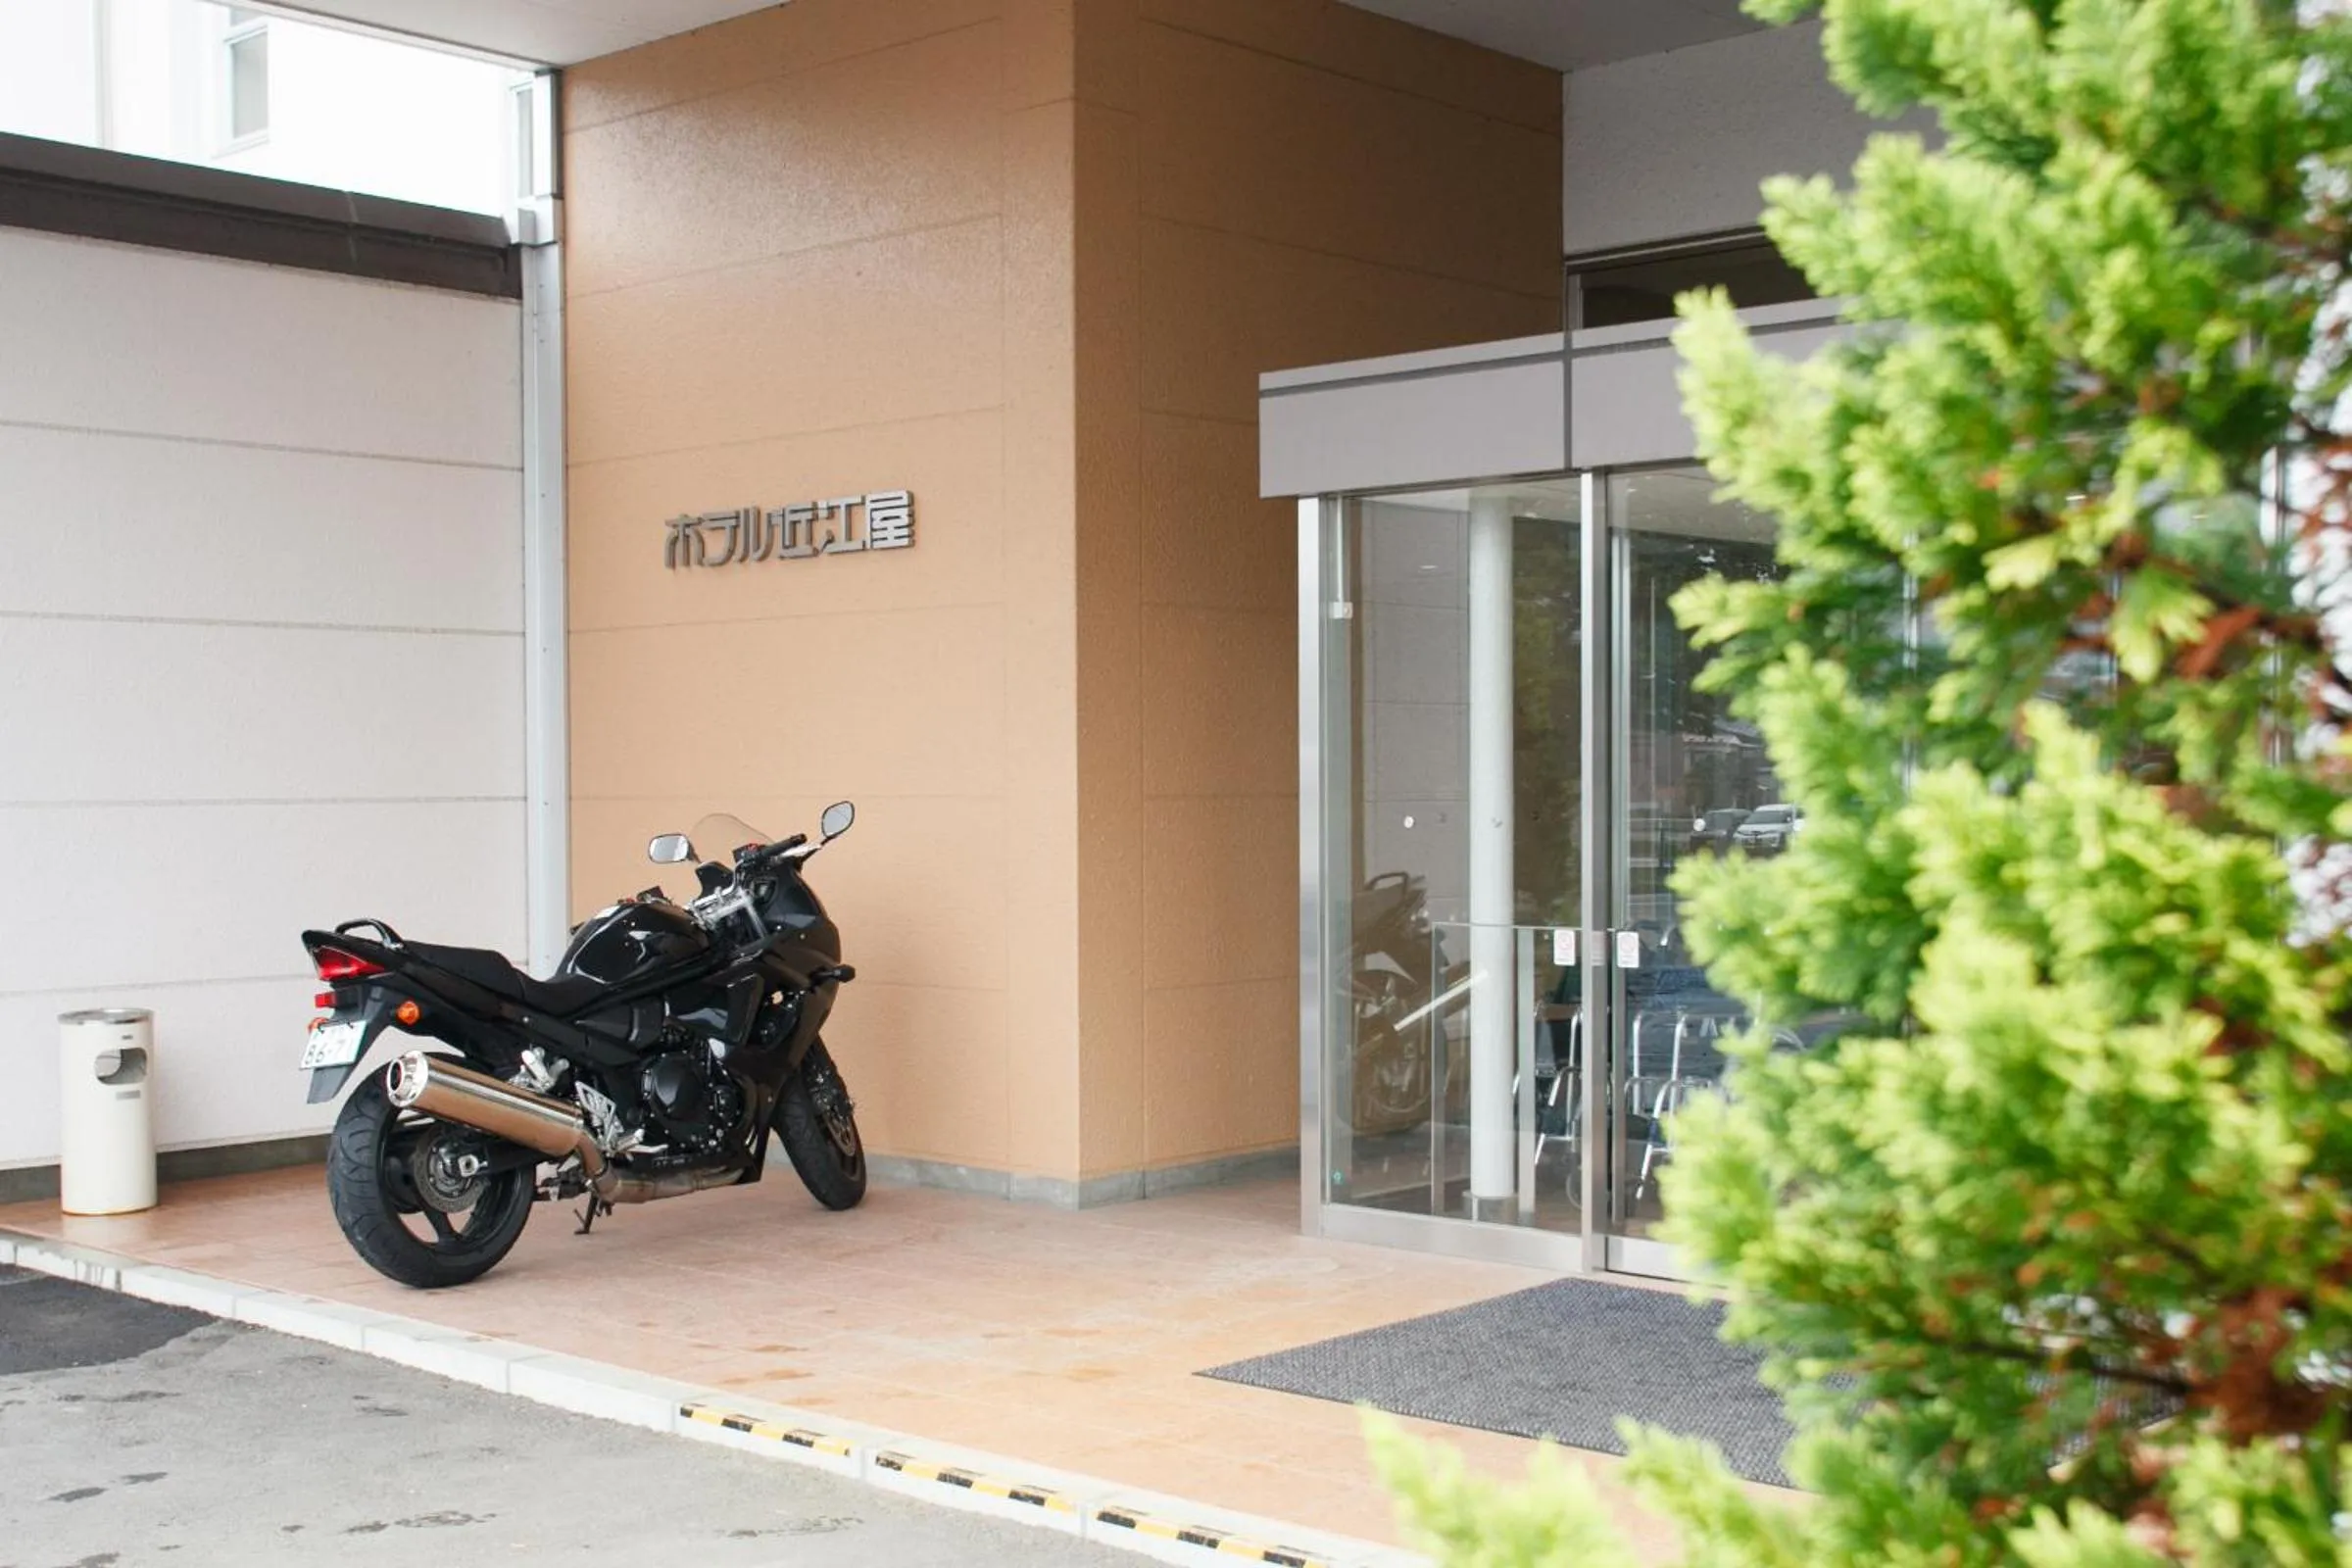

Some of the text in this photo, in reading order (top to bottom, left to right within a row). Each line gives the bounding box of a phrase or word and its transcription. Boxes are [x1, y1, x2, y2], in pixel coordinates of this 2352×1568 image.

[664, 490, 915, 570] ホテル近江屋
